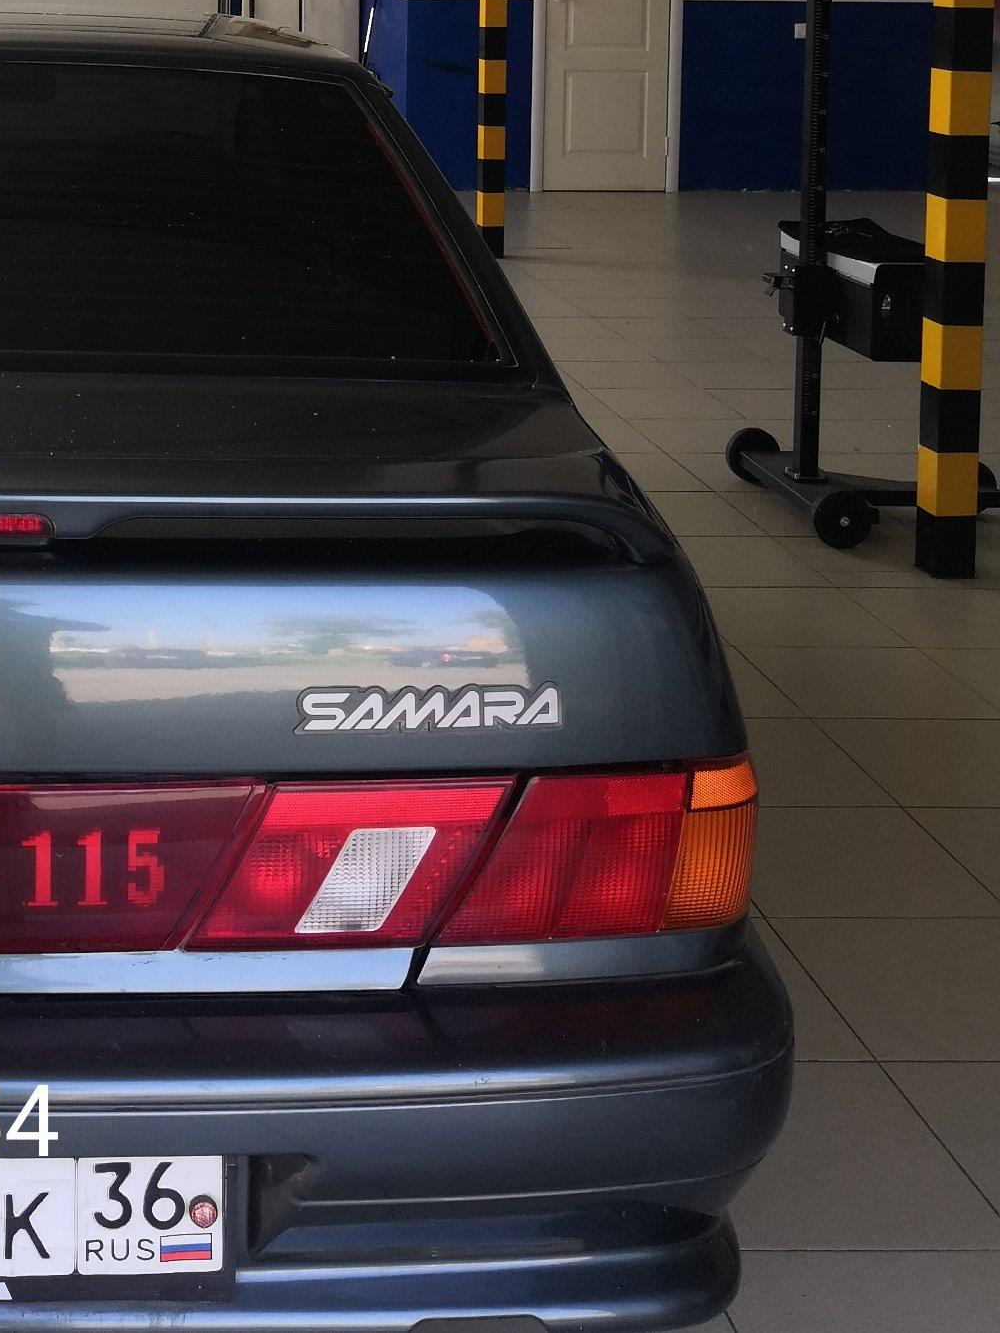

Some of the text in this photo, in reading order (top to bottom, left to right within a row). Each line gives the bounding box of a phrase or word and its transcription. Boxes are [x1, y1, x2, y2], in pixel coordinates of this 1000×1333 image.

[298, 684, 562, 733] SAMARA
[21, 827, 167, 908] 115
[91, 1161, 184, 1230] 36
[84, 1238, 155, 1263] RUS
